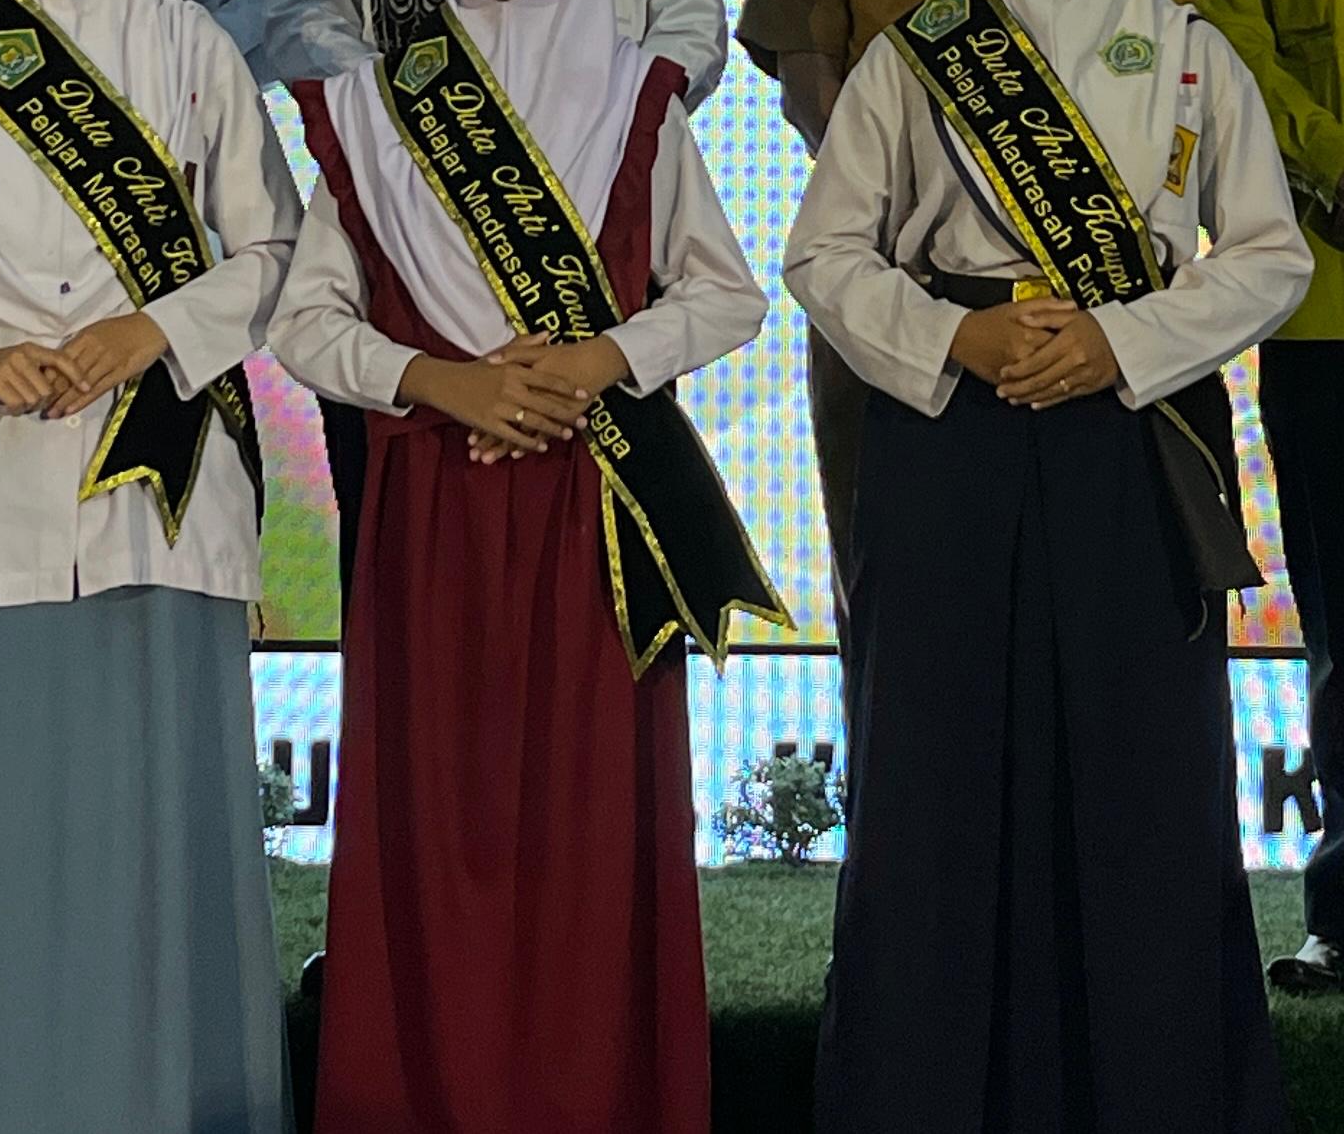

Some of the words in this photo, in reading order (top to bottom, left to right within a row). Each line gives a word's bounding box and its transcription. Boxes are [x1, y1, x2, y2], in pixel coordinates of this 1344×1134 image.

[16, 97, 87, 171] Pelajar
[83, 172, 162, 296] Madrasah
[47, 79, 113, 148] Duta
[113, 156, 177, 226] Anti
[411, 97, 467, 177] Pelajar
[460, 180, 543, 308] Madrasah
[441, 81, 496, 155] Duta
[492, 166, 559, 237] Anti
[937, 46, 994, 119] Pelajar
[989, 120, 1073, 251] Madrasah
[967, 28, 1024, 97] Duta
[1020, 107, 1090, 180] Anti
[1070, 194, 1143, 294] Korupsi
